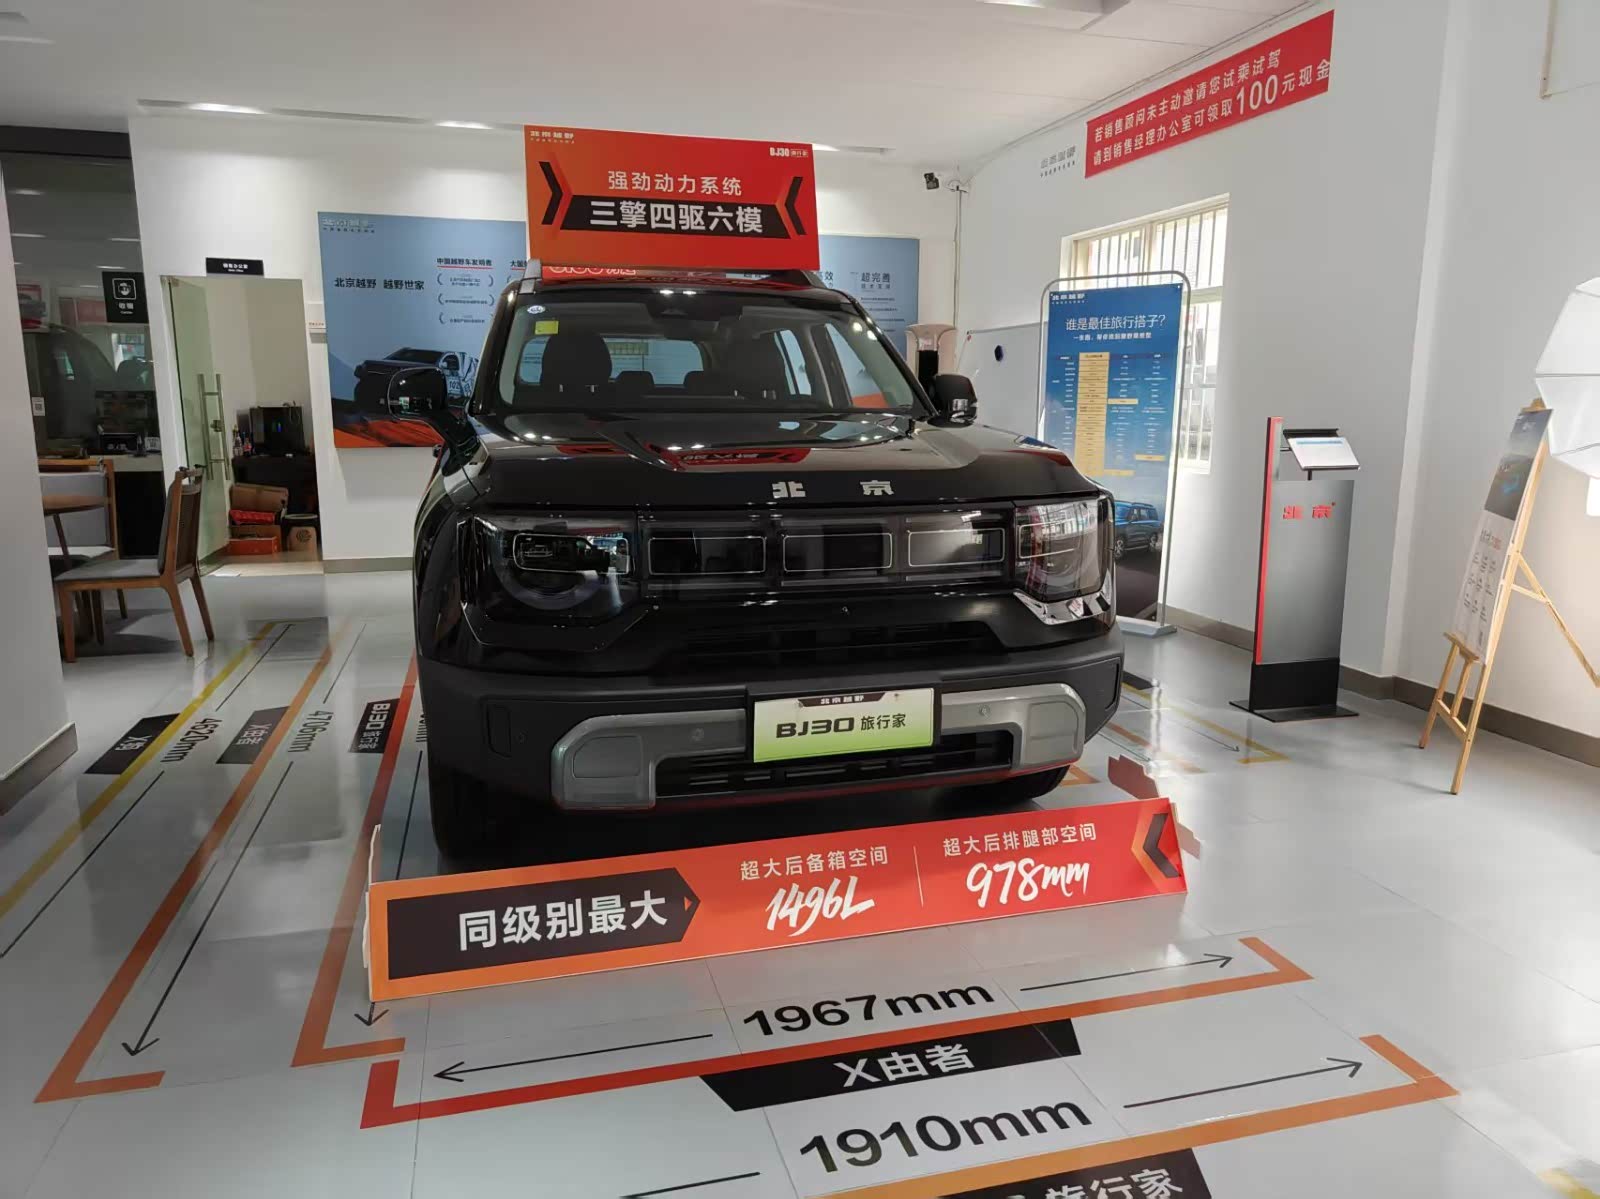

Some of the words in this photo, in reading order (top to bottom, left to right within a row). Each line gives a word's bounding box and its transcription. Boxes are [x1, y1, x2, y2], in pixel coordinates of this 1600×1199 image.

[608, 170, 742, 196] 强劲动力系统
[589, 199, 764, 234] 三擎四驱六模
[334, 277, 377, 289] 北京越野
[383, 279, 425, 291] 越野世家
[771, 480, 894, 498] 北京
[160, 718, 223, 763] 4620mm
[287, 710, 335, 753] 4706mm
[776, 717, 855, 739] BJ30
[860, 713, 907, 731] 旅行家
[943, 822, 1098, 857] 超大后排腿部空间
[740, 845, 889, 881] 超大后备箱空间
[966, 858, 1091, 908] 978mm
[459, 889, 668, 952] 同级别最大
[765, 875, 876, 937] 1496L
[743, 984, 996, 1038] 1967mm
[833, 1042, 976, 1088] X由者
[798, 1100, 1093, 1174] 1910mm
